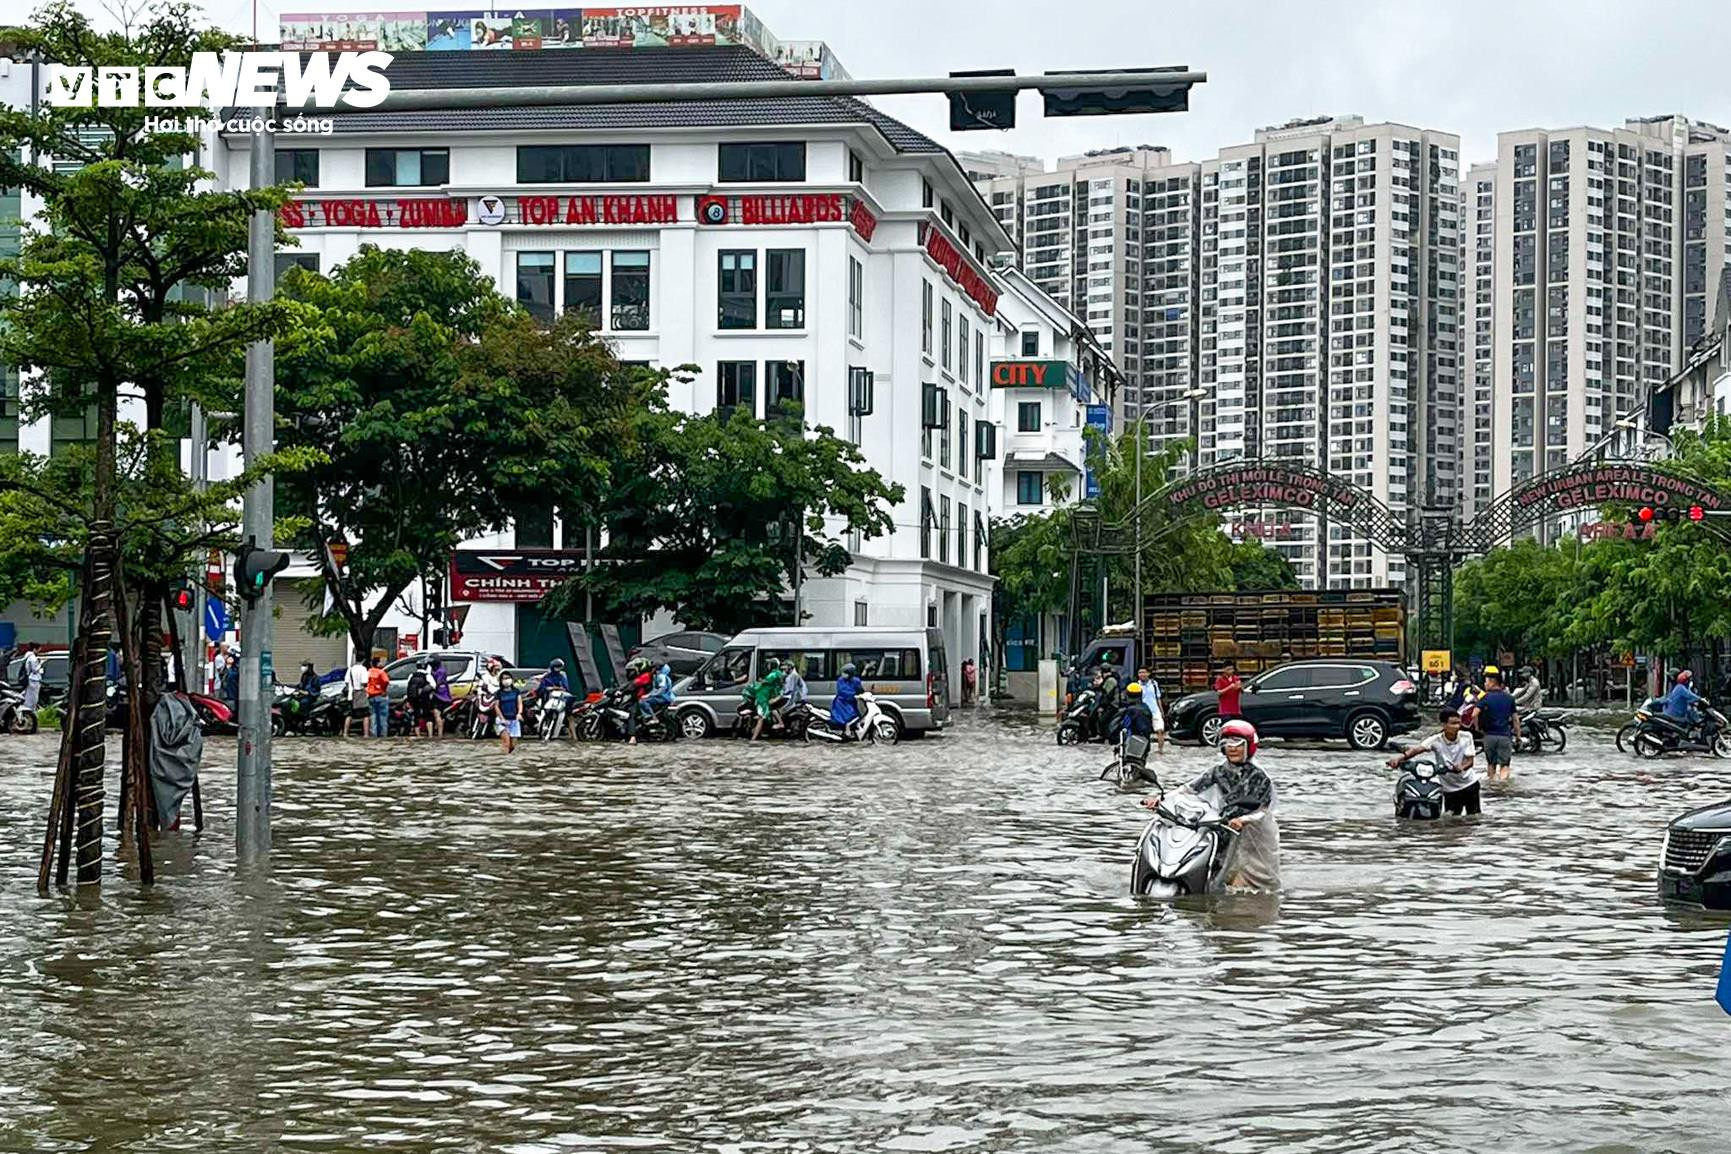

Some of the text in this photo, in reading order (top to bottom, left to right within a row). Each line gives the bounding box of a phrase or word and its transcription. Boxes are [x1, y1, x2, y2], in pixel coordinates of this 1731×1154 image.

[320, 14, 385, 22] YOGA
[321, 200, 381, 227] YOGA
[398, 199, 468, 228] ZUMBA
[517, 195, 678, 225] TOP AN KHANH
[742, 194, 842, 224] BILLIARDS
[993, 363, 1048, 385] CITY
[1169, 485, 1196, 504] KHU
[1204, 484, 1311, 508] GELEXIMCO
[1519, 470, 1721, 510] NEW URBAN AREA LE TRONG TAN
[1558, 484, 1669, 508] GELEXIMCO
[527, 558, 576, 567] TOP
[464, 576, 531, 588] CHÍNH
